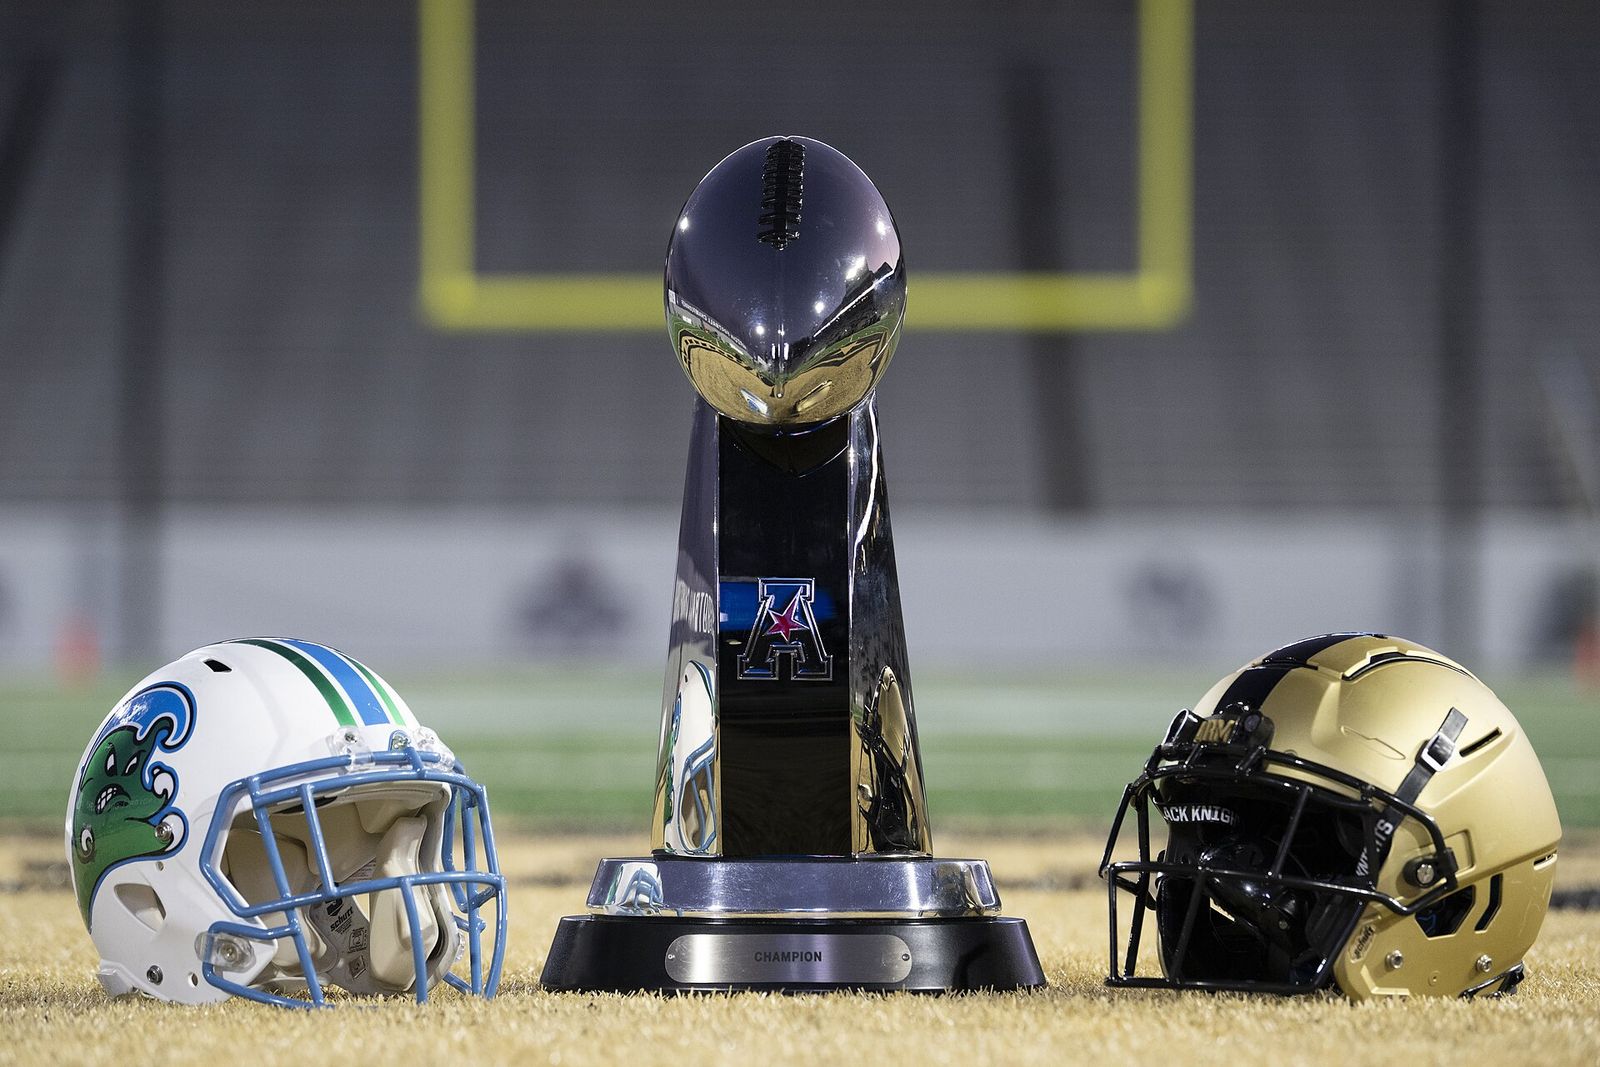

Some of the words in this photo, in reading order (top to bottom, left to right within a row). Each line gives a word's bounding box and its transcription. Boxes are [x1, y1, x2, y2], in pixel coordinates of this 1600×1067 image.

[737, 577, 833, 681] A
[1194, 719, 1235, 743] ARM
[1163, 805, 1189, 822] ACK
[754, 951, 822, 962] CHAMPION
